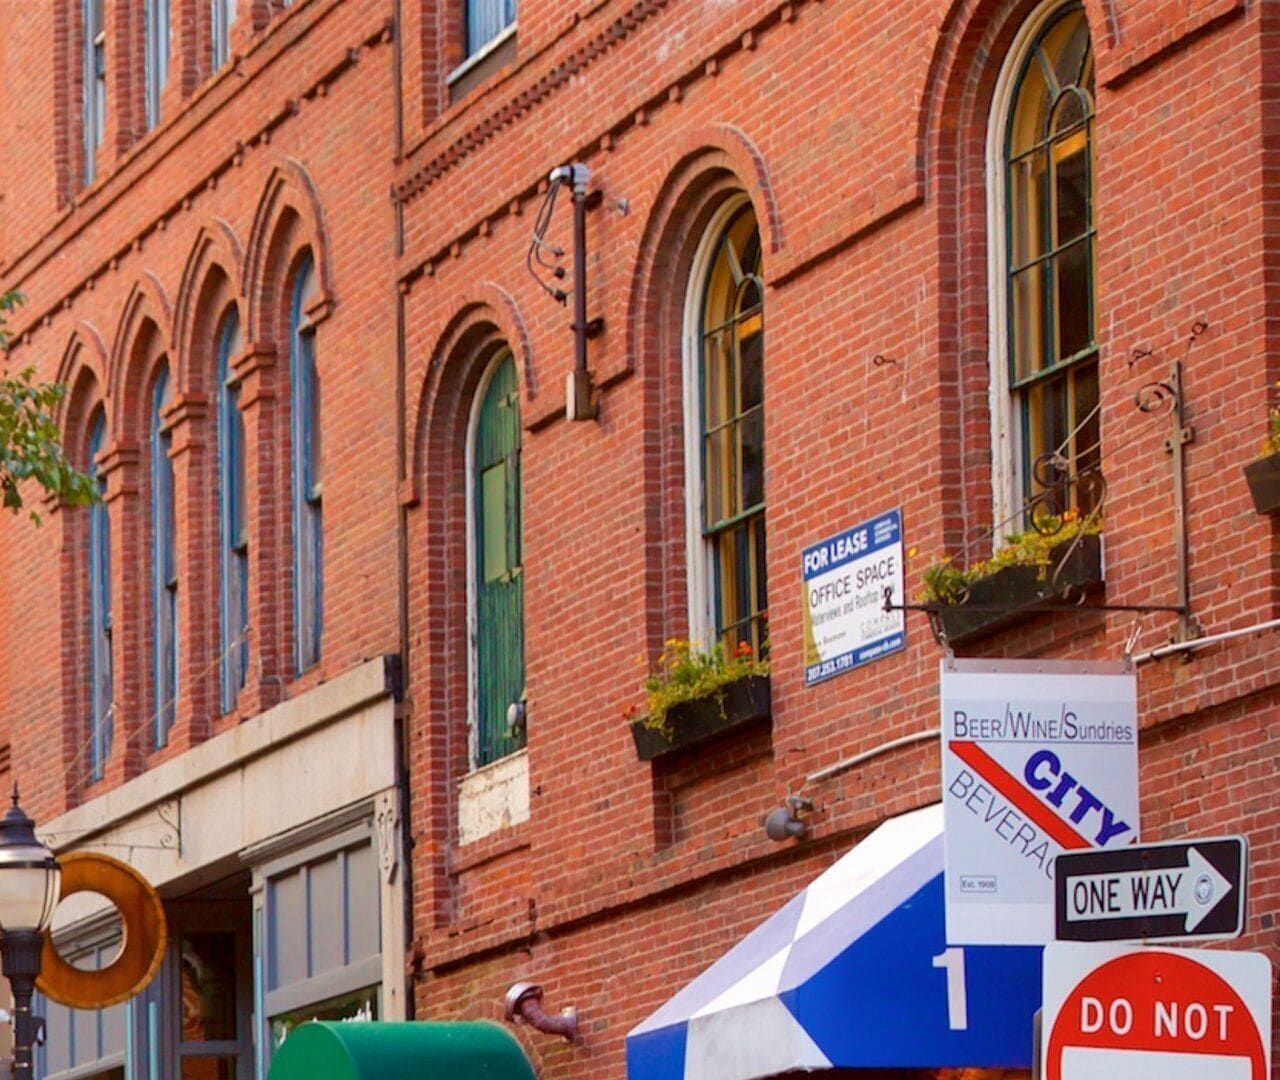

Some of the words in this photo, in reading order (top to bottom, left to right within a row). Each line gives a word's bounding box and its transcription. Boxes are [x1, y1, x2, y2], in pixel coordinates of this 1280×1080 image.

[804, 547, 828, 575] FOR
[831, 528, 868, 564] LEASE
[810, 575, 851, 608] OFFICE
[856, 556, 895, 589] SPACE
[1024, 749, 1131, 847] CITY
[1073, 878, 1121, 915] ONE
[1131, 873, 1183, 911] WAY
[932, 947, 968, 1031] 1
[1081, 996, 1133, 1036] DO
[1154, 1001, 1234, 1041] NOT
